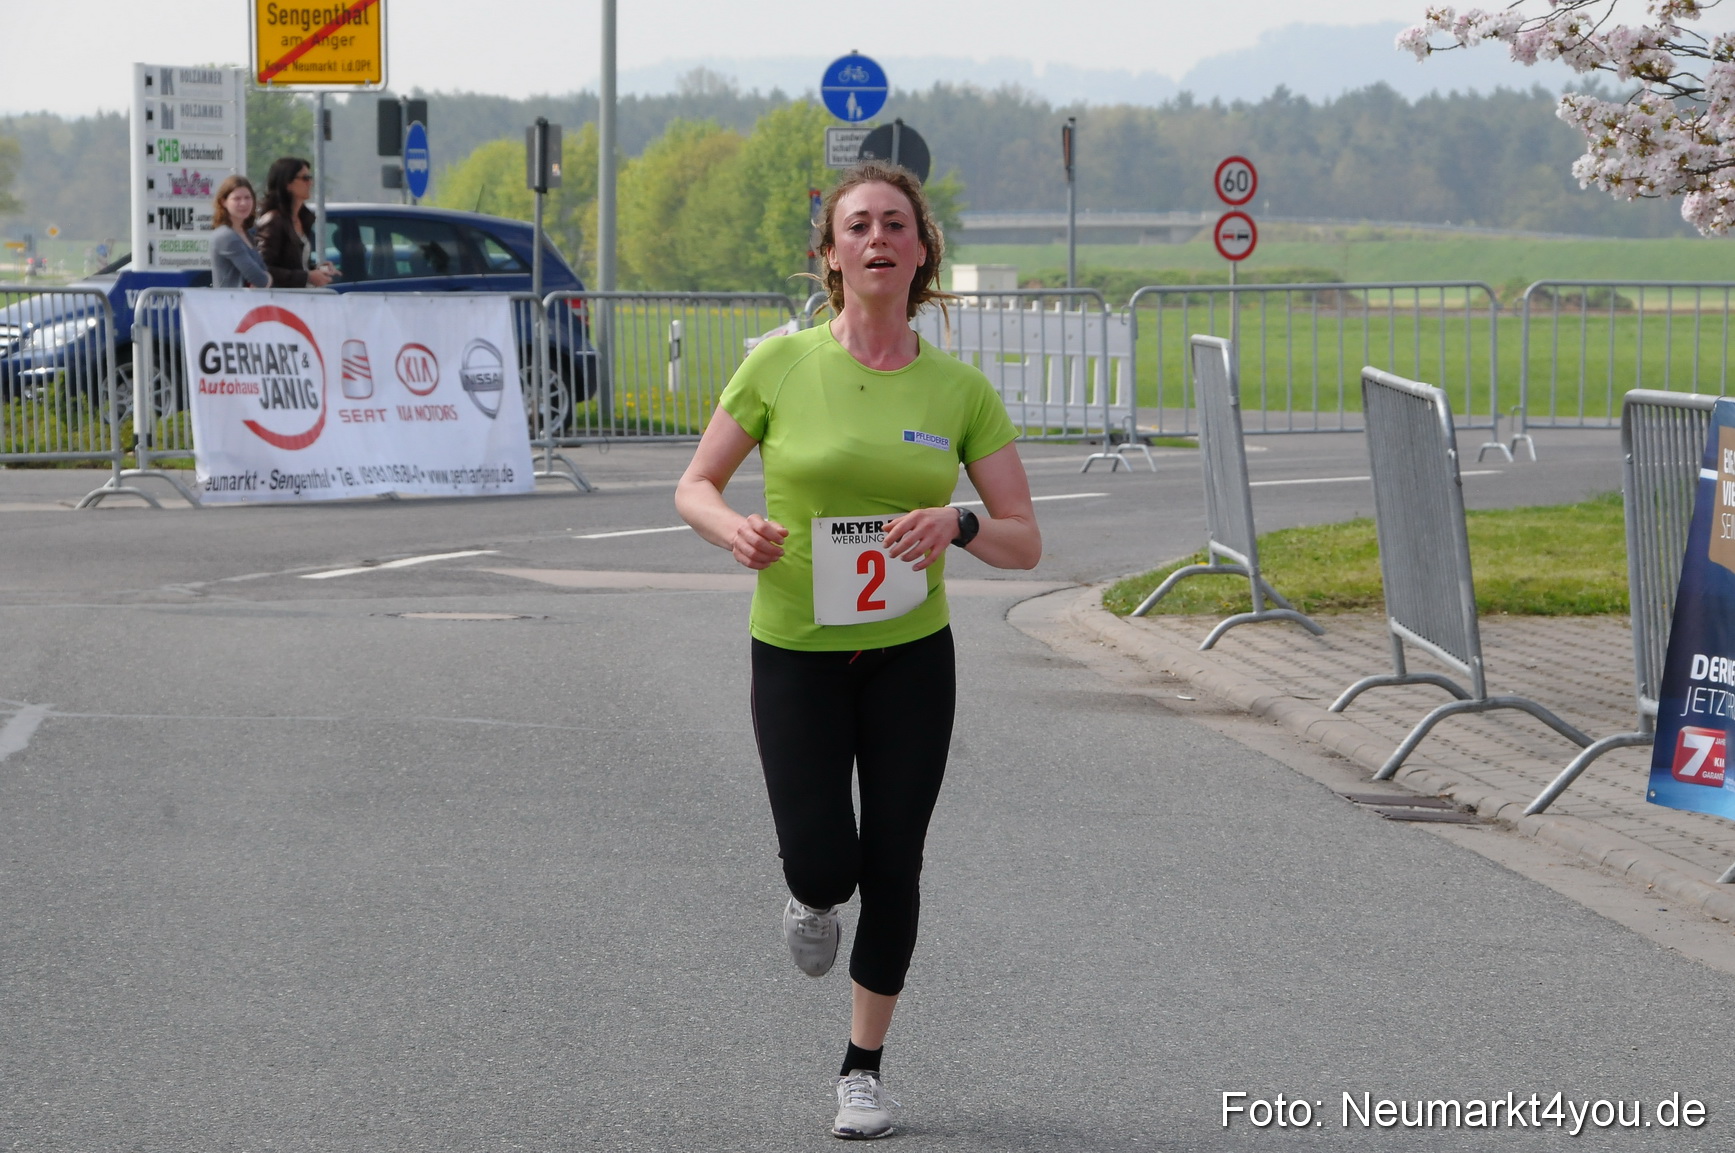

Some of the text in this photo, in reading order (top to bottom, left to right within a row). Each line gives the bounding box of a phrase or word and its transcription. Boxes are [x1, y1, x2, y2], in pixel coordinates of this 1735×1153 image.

[267, 2, 370, 32] Sengenthal
[280, 33, 356, 50] am Anger
[293, 60, 338, 72] Neumarkt
[157, 138, 179, 163] SHB
[1223, 169, 1248, 192] 60
[158, 207, 194, 230] THULE
[198, 341, 310, 375] GERHART &
[199, 378, 319, 410] Autohaus JÄNIG
[338, 408, 387, 423] SEAT
[415, 404, 458, 421] MOTORS
[915, 431, 949, 446] PFLEIDERER
[205, 470, 257, 492] eumarkt
[269, 468, 331, 494] Sengenthal
[831, 521, 884, 535] MEYER
[831, 534, 885, 545] WERBUNG
[856, 550, 886, 612] 2
[1678, 733, 1716, 777] 7
